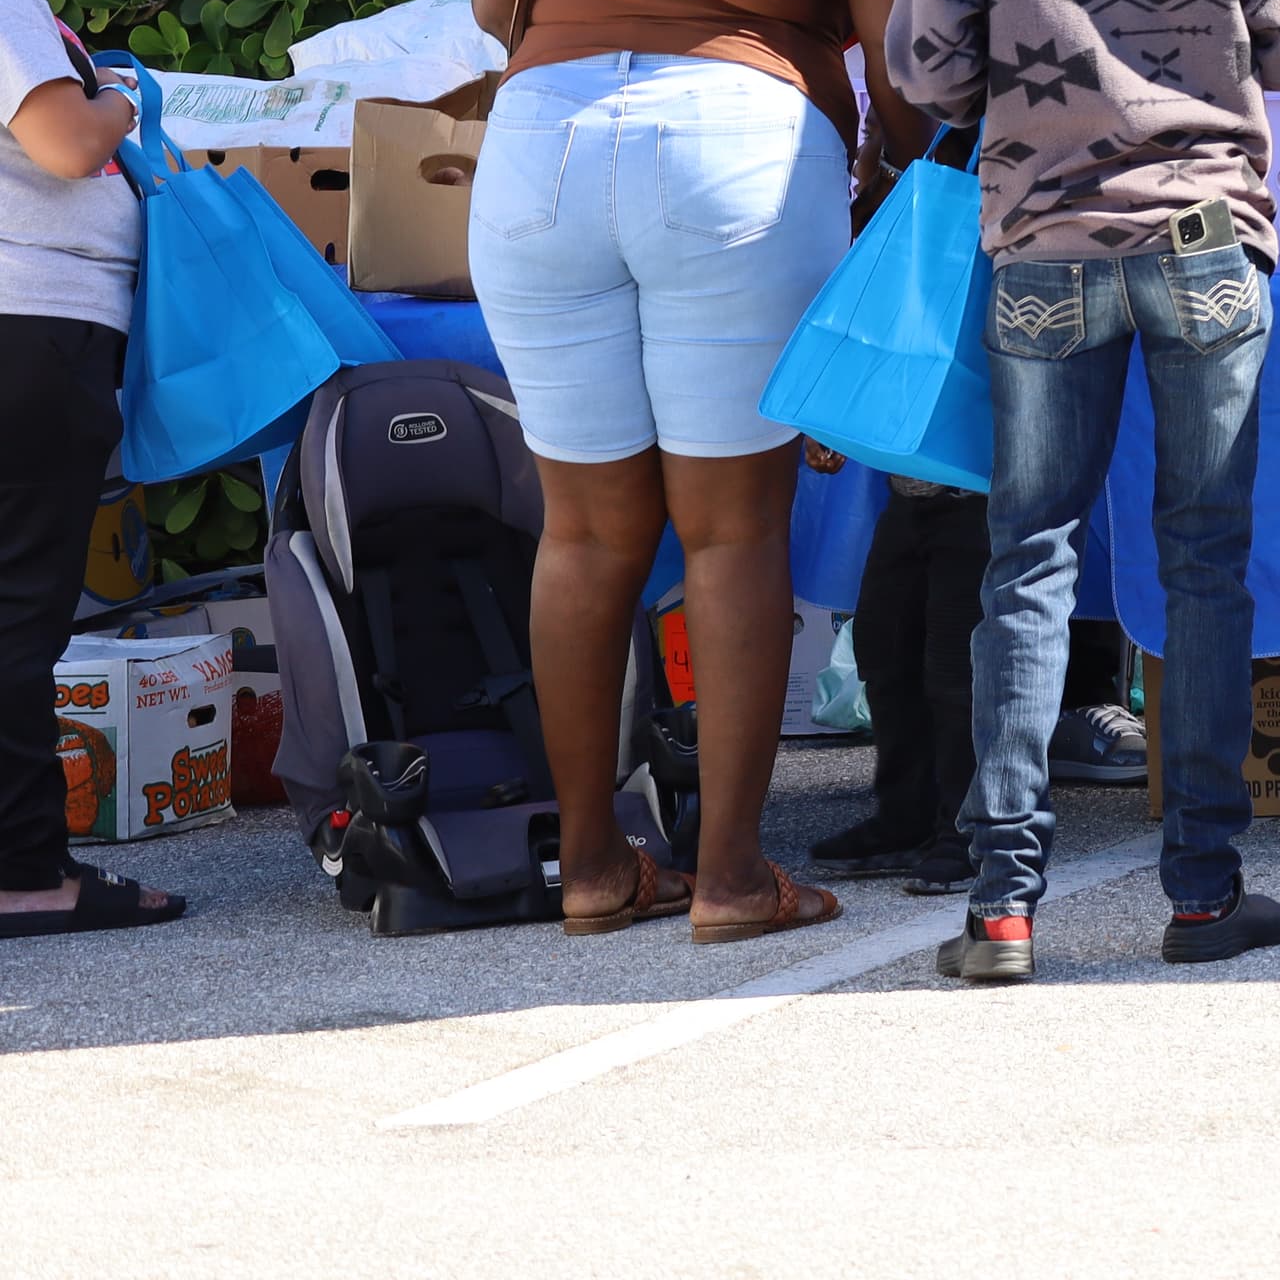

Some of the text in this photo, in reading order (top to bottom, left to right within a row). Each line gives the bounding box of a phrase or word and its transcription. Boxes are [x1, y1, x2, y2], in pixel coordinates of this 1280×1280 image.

[674, 650, 690, 673] 4
[139, 673, 157, 689] 40
[136, 685, 191, 709] NET WT.
